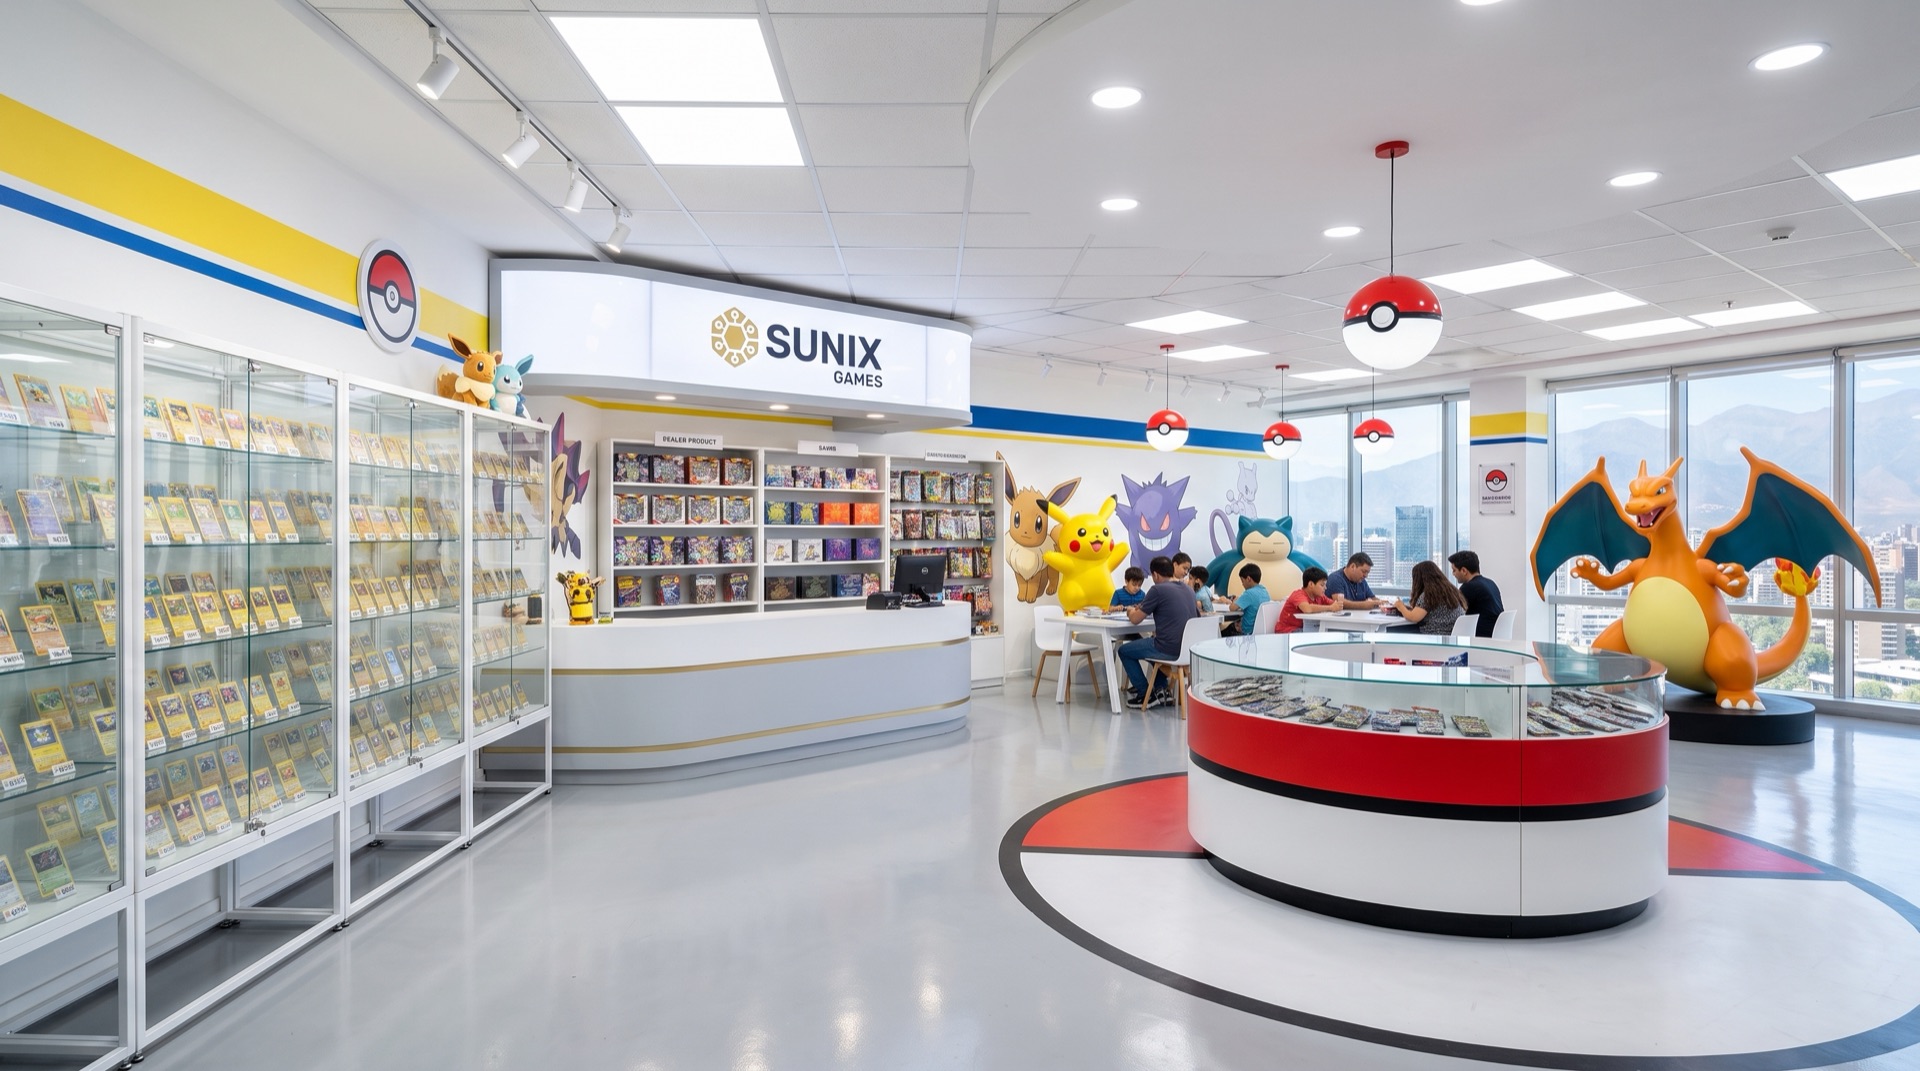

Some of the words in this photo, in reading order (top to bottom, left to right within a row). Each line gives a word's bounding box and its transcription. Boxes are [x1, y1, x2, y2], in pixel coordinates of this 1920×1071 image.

[765, 324, 882, 370] SUNIX
[833, 370, 883, 388] GAMES
[662, 435, 687, 444] DEALER
[688, 437, 717, 446] PRODUCT
